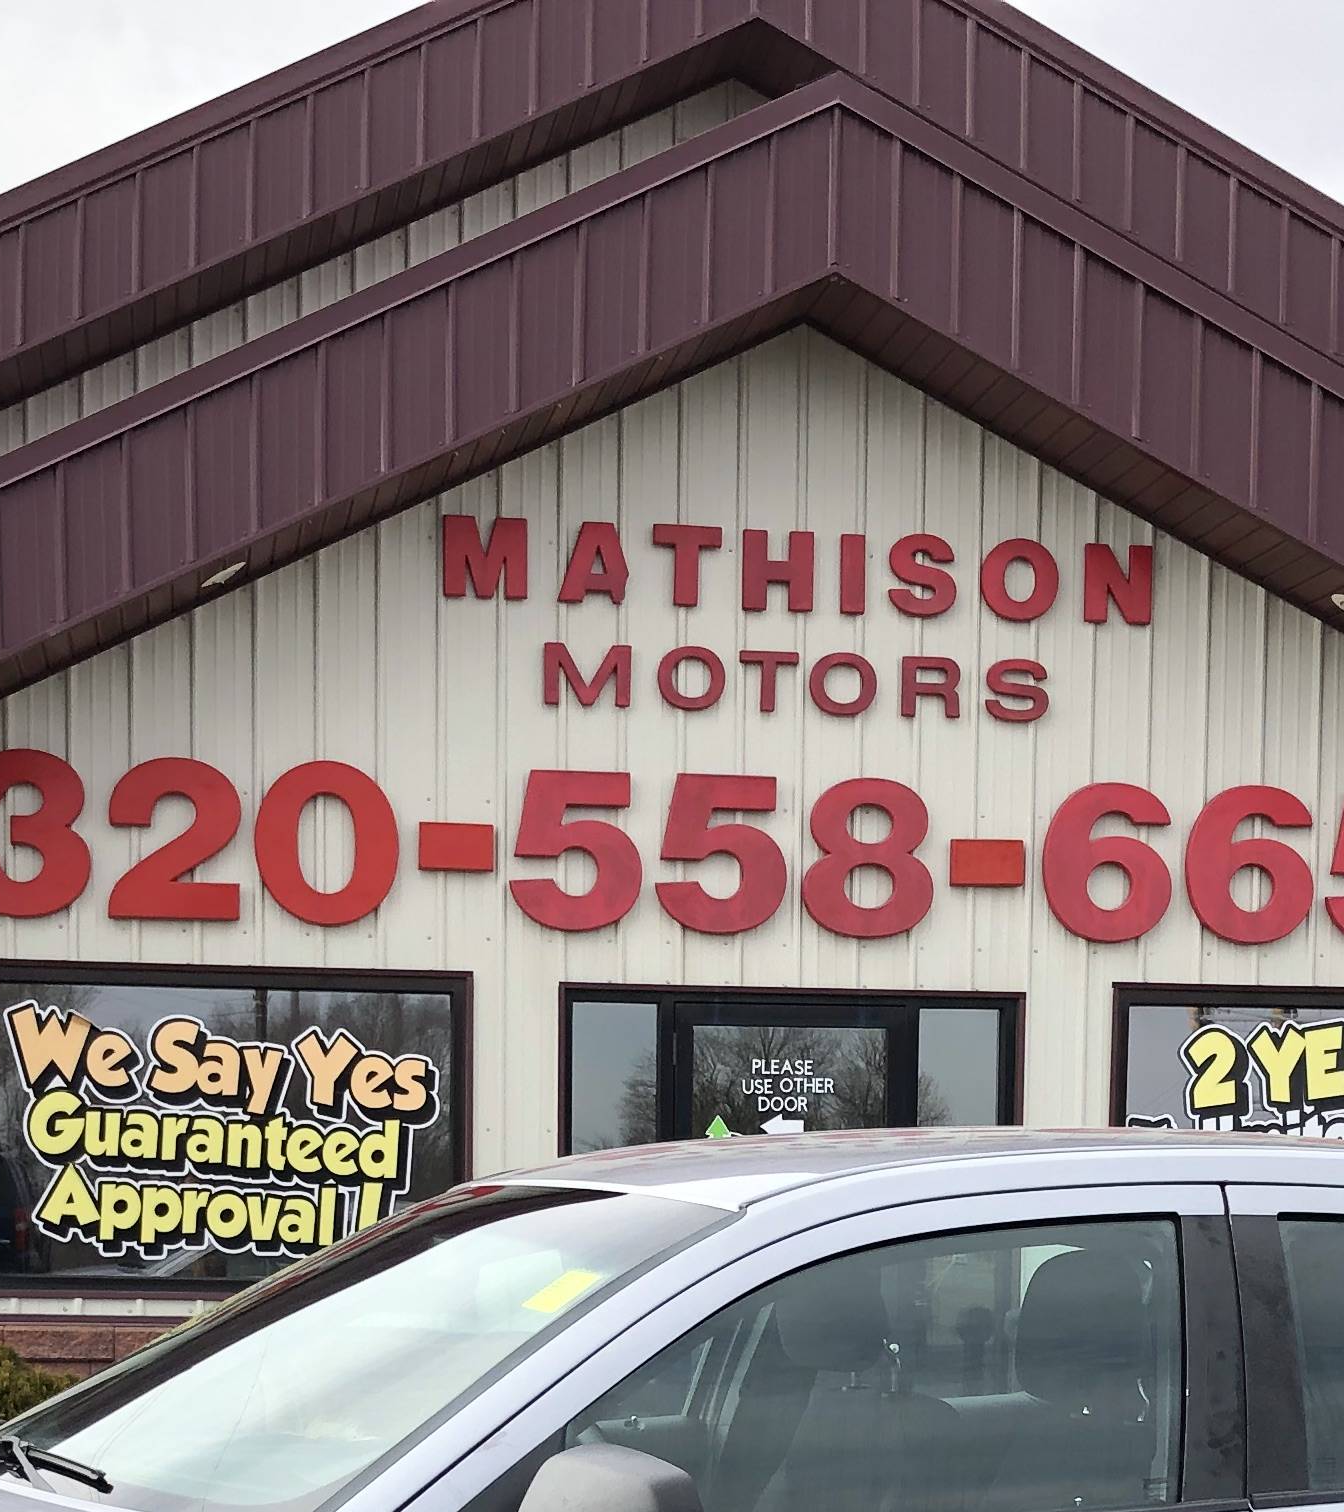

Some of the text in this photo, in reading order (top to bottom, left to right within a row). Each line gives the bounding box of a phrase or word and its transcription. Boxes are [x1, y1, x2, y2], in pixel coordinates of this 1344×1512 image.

[443, 514, 1154, 626] MATHISON
[543, 641, 1051, 722] MOTORS
[10, 1003, 428, 1115] We Say Yes
[741, 1077, 835, 1095] USE OTHER
[751, 1058, 814, 1076] PLEASE
[1186, 1030, 1237, 1110] 2
[27, 1089, 402, 1180] Guaranteed
[757, 1096, 809, 1112] DOOR
